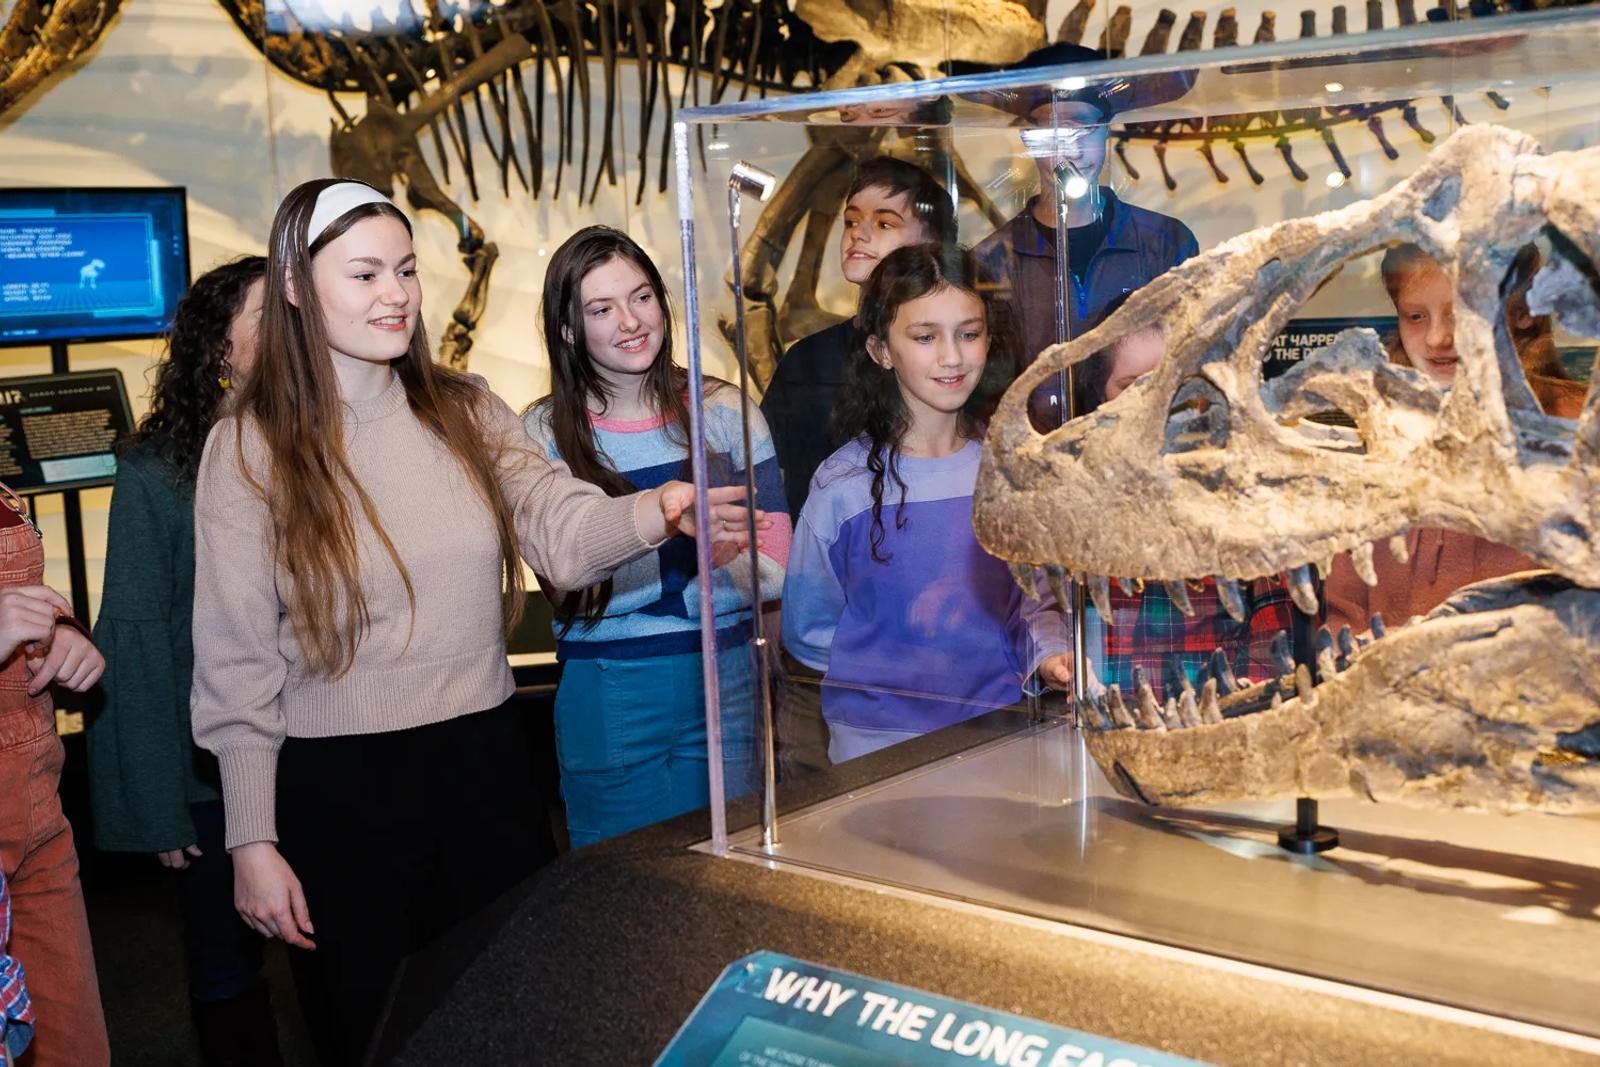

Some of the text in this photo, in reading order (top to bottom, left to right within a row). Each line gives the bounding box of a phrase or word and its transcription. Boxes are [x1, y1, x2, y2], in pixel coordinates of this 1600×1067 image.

[1271, 334, 1337, 347] AT HAPPE
[1275, 348, 1300, 360] THE
[764, 967, 858, 1017] WHY
[856, 991, 937, 1041] THE
[930, 1012, 1050, 1067] LONG
